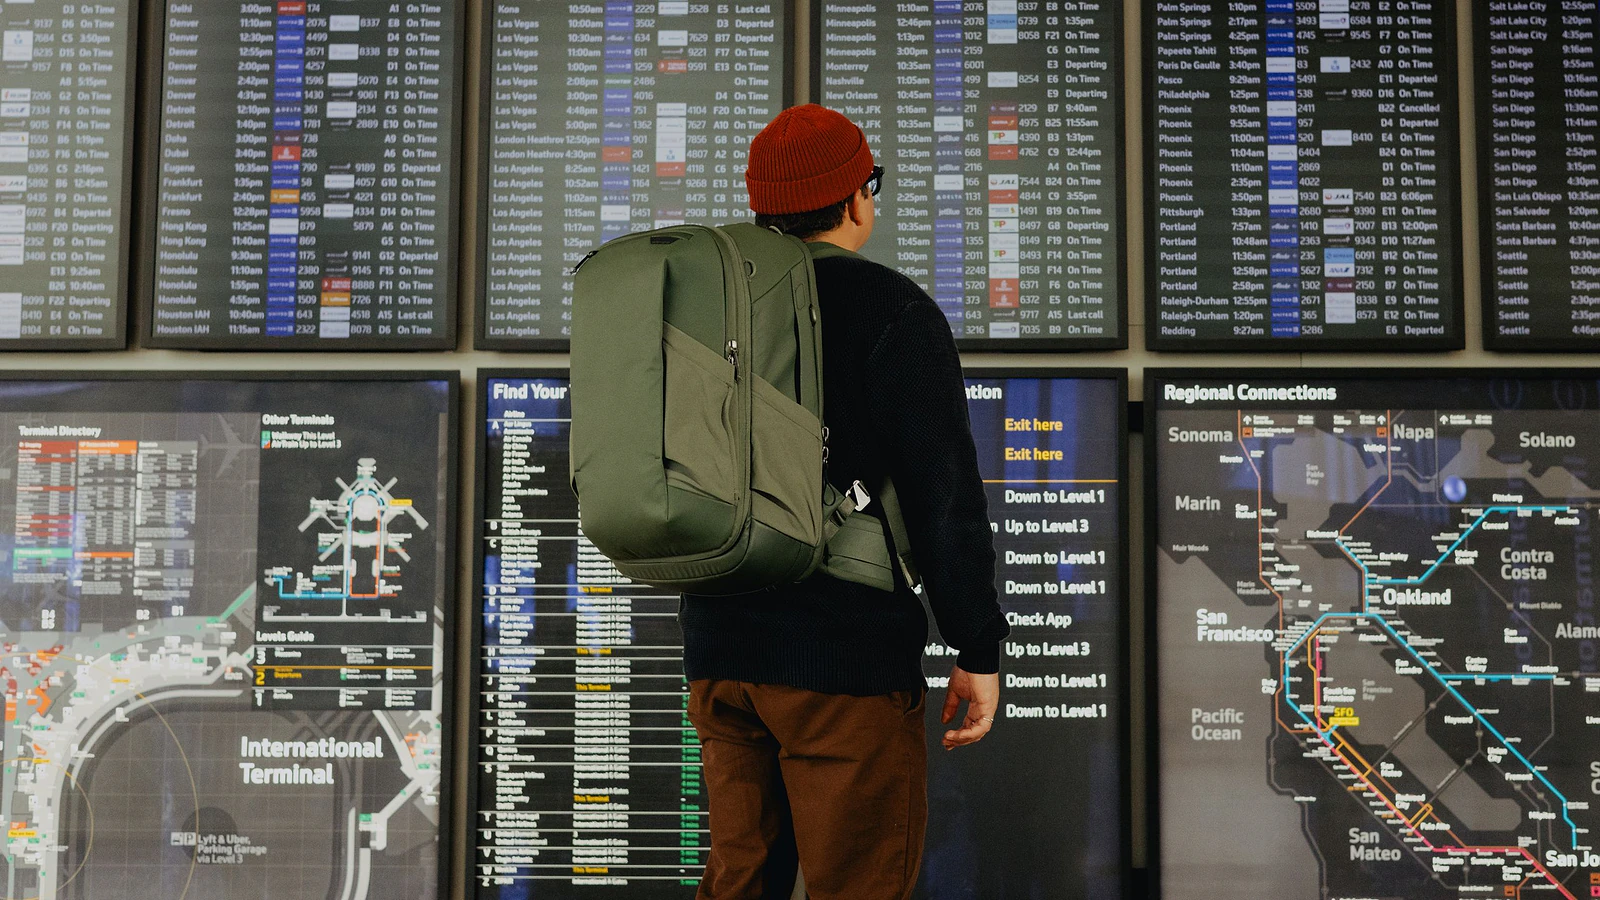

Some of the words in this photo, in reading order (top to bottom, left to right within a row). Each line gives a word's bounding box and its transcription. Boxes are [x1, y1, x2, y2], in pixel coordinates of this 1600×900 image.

[498, 5, 519, 13] Kona
[569, 5, 603, 13] 10:50am
[635, 5, 655, 13] 2229
[717, 5, 728, 13] E5
[736, 5, 753, 13] Last
[753, 5, 770, 13] call
[80, 20, 92, 28] On
[94, 19, 114, 28] Time
[170, 18, 198, 27] Denver
[240, 18, 271, 27] 11:10am
[306, 18, 326, 27] 2076
[406, 19, 418, 27] On
[420, 19, 440, 27] Time
[826, 19, 876, 28] Minneapolis
[897, 18, 931, 27] 12:46pm
[964, 17, 984, 25] 2078
[1018, 17, 1038, 25] 6739
[1065, 17, 1094, 26] 1:35pm
[1490, 17, 1509, 25] Salt
[1509, 17, 1528, 25] Lake
[1530, 17, 1547, 26] City
[1562, 16, 1592, 25] 1:20pm
[1158, 47, 1195, 56] Papeete
[1194, 46, 1216, 54] Tahiti
[1229, 46, 1257, 56] 1:15pm
[1297, 46, 1309, 54] 115
[1379, 45, 1391, 54] G7
[1398, 45, 1410, 53] On
[1412, 45, 1432, 53] Time
[826, 62, 869, 72] Monterrey
[897, 62, 931, 70] 10:35am
[964, 61, 984, 69] 6001
[1047, 60, 1058, 68] E3
[1066, 60, 1107, 70] Departing
[1159, 105, 1192, 113] Phoenix
[1230, 105, 1260, 113] 9:10am
[1296, 104, 1315, 112] 2411
[1399, 104, 1440, 112] Cancelled
[1497, 237, 1521, 245] Santa
[1523, 236, 1556, 245] Barbara
[1569, 236, 1599, 245] 4:37pm
[158, 310, 193, 319] Houston
[195, 310, 210, 318] IAH
[230, 310, 264, 319] 10:40am
[378, 310, 392, 319] A15
[415, 311, 433, 319] call
[1162, 326, 1195, 336] Redding
[1233, 326, 1264, 334] 9:27am
[1302, 326, 1323, 334] 5286
[1386, 326, 1397, 334] E6
[1405, 325, 1444, 335] Departed
[494, 384, 528, 399] Find
[529, 382, 567, 400] Your
[1165, 385, 1235, 403] Regional
[1237, 384, 1336, 400] Connections
[262, 414, 289, 425] Other
[290, 414, 334, 425] Terminals
[1005, 418, 1031, 431] Exit
[1033, 418, 1063, 431] here
[19, 426, 58, 436] Terminal
[59, 426, 101, 438] Directory
[1169, 427, 1233, 442] Sonoma
[1394, 424, 1434, 442] Napa
[1520, 432, 1575, 447] Solano
[1005, 448, 1031, 461] Exit
[1033, 448, 1063, 461] here
[1005, 490, 1041, 503] Down
[1043, 490, 1057, 503] to
[1060, 490, 1096, 503] Level
[1097, 490, 1105, 503] 1
[1176, 496, 1220, 510] Marin
[1005, 520, 1024, 534] Up
[1026, 521, 1039, 532] to
[1043, 520, 1078, 533] Level
[1080, 520, 1089, 533] 3
[1006, 552, 1041, 565] Down
[1044, 552, 1058, 565] to
[1061, 552, 1096, 565] Level
[1098, 552, 1105, 565] 1
[1501, 547, 1554, 563] Contra
[1501, 564, 1547, 580] Costa
[1006, 581, 1041, 594] Down
[1044, 581, 1058, 594] to
[1061, 581, 1097, 594] Level
[1098, 581, 1106, 594] 1
[1237, 581, 1255, 589] Marin
[1383, 588, 1451, 605] Oakland
[136, 610, 150, 620] B2
[172, 606, 183, 616] B1
[1197, 609, 1227, 624] San
[1006, 612, 1043, 626] Check
[1046, 612, 1072, 628] App
[256, 631, 286, 641] Levels
[287, 631, 314, 642] Guide
[1197, 626, 1273, 642] Francisco
[925, 643, 944, 656] via
[1006, 642, 1024, 656] Up
[1026, 643, 1040, 654] to
[1044, 642, 1079, 655] Level
[1081, 642, 1090, 655] 3
[256, 651, 266, 664] 3
[256, 671, 265, 685] 2
[1006, 674, 1042, 687] Down
[1045, 674, 1059, 687] to
[1061, 674, 1097, 687] Level
[1099, 674, 1106, 687] 1
[255, 692, 262, 706] 1
[1007, 705, 1042, 718] Down
[1045, 705, 1059, 718] to
[1062, 705, 1097, 718] Level
[1099, 705, 1106, 718] 1
[1192, 708, 1244, 723] Pacific
[1333, 707, 1355, 718] SFO
[1192, 725, 1241, 740] Ocean
[241, 736, 383, 758] International
[239, 763, 334, 784] Terminal
[198, 834, 217, 846] Lyft
[218, 834, 225, 844] &
[226, 834, 251, 845] Uber,
[1349, 828, 1379, 843] San
[197, 844, 232, 855] Parking
[234, 844, 267, 856] Garage
[1350, 845, 1401, 861] Mateo
[197, 854, 210, 864] via
[212, 853, 235, 864] Level
[237, 853, 243, 863] 3
[1546, 849, 1580, 867] San
